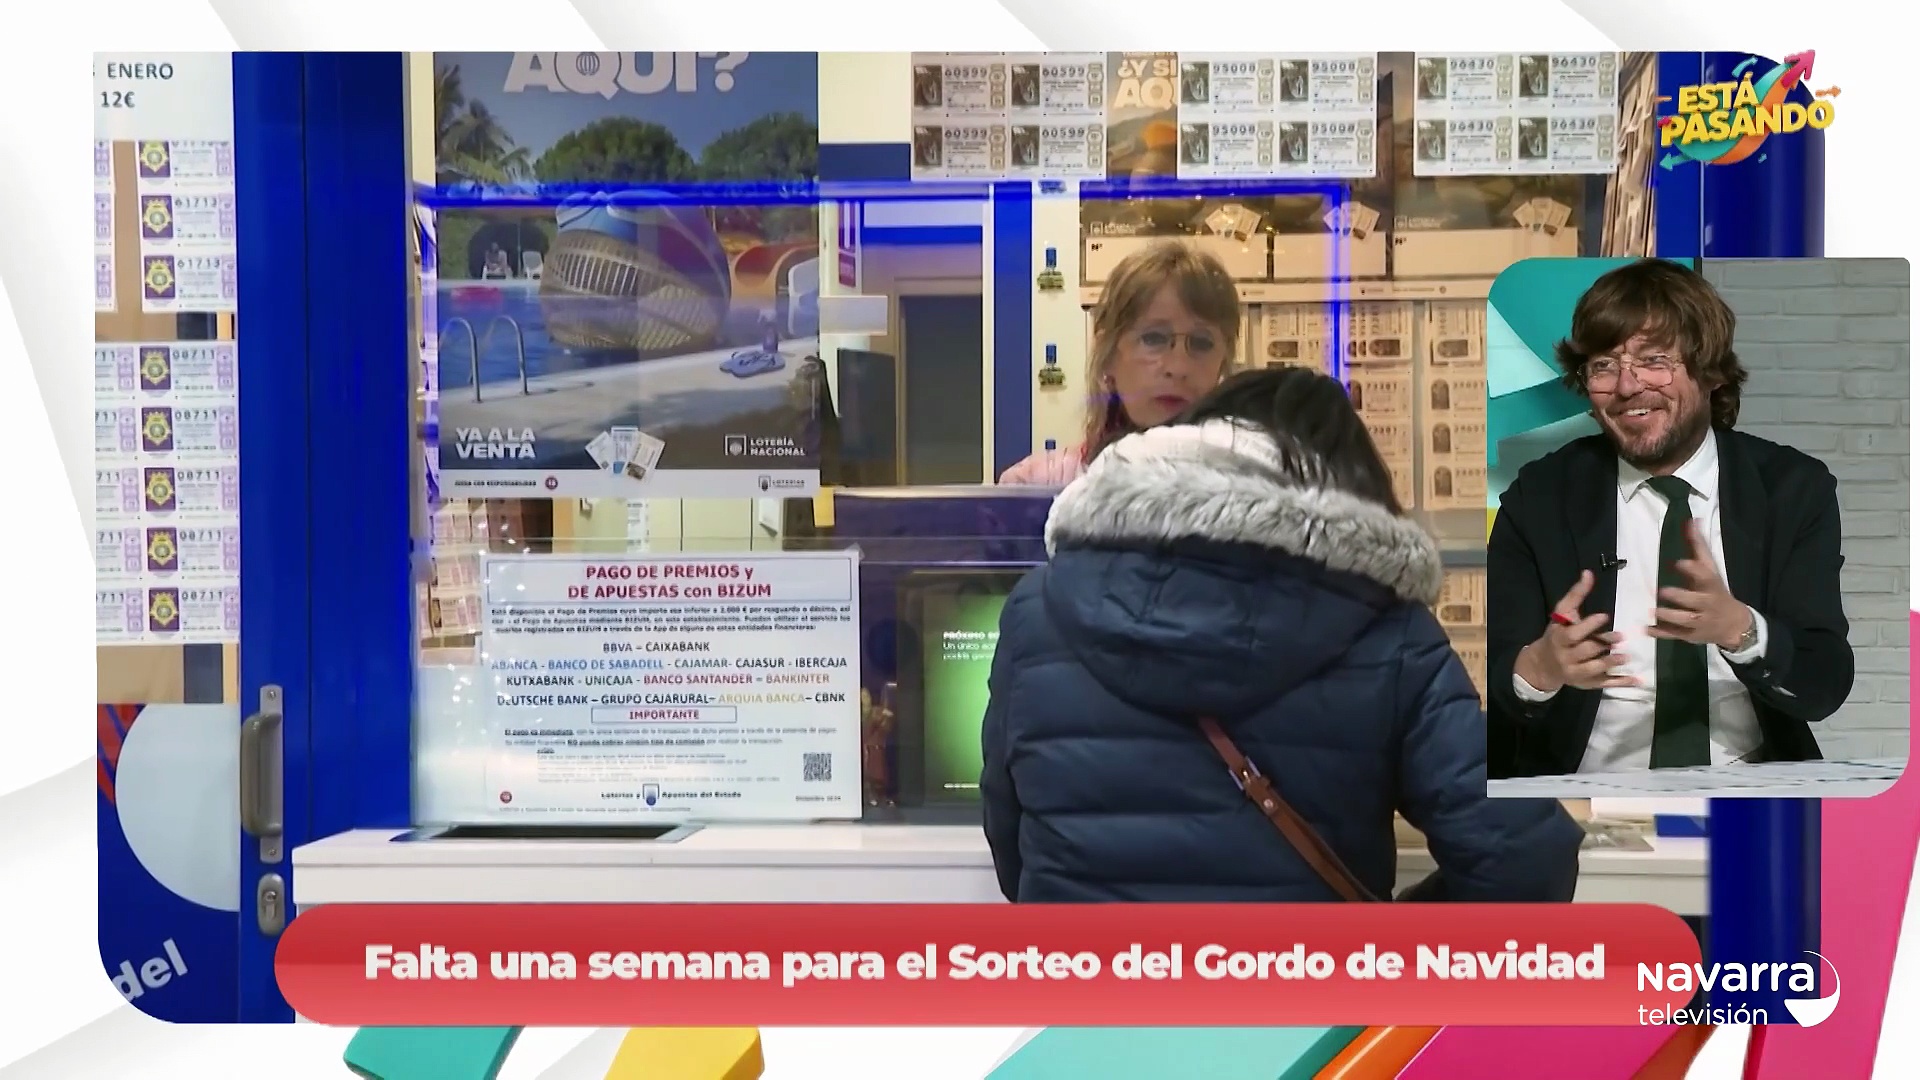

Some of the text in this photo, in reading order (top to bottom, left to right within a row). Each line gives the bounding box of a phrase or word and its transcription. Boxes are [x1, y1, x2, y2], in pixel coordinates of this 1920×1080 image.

[107, 62, 174, 80] ENERO
[1117, 59, 1177, 78] ¿Y SI
[100, 91, 136, 108] 12€
[1113, 77, 1178, 110] AQ
[455, 427, 536, 442] YA A LA
[455, 442, 537, 460] VENTA
[750, 447, 806, 456] NACIONAL
[586, 564, 754, 581] PAGO DE PREMIOS y
[568, 584, 772, 599] DE APUESTAS con BIZUM
[603, 642, 711, 653] BBVA CAIXABANK
[492, 660, 538, 670] ABANCA
[548, 659, 588, 670] BANCO
[591, 659, 606, 670] DE
[608, 658, 664, 670] SABADELL
[735, 657, 785, 668] CAJASUR
[795, 657, 848, 668] IBERCAJA
[506, 673, 830, 686] KUTXABANK UNICAJA BANCO SANTANDER BANKINTER
[557, 695, 588, 705] BANK
[602, 694, 642, 704] GRUPO
[815, 692, 846, 702] CBNK
[630, 710, 700, 720] IMPORTANTE
[112, 938, 188, 1002] del
